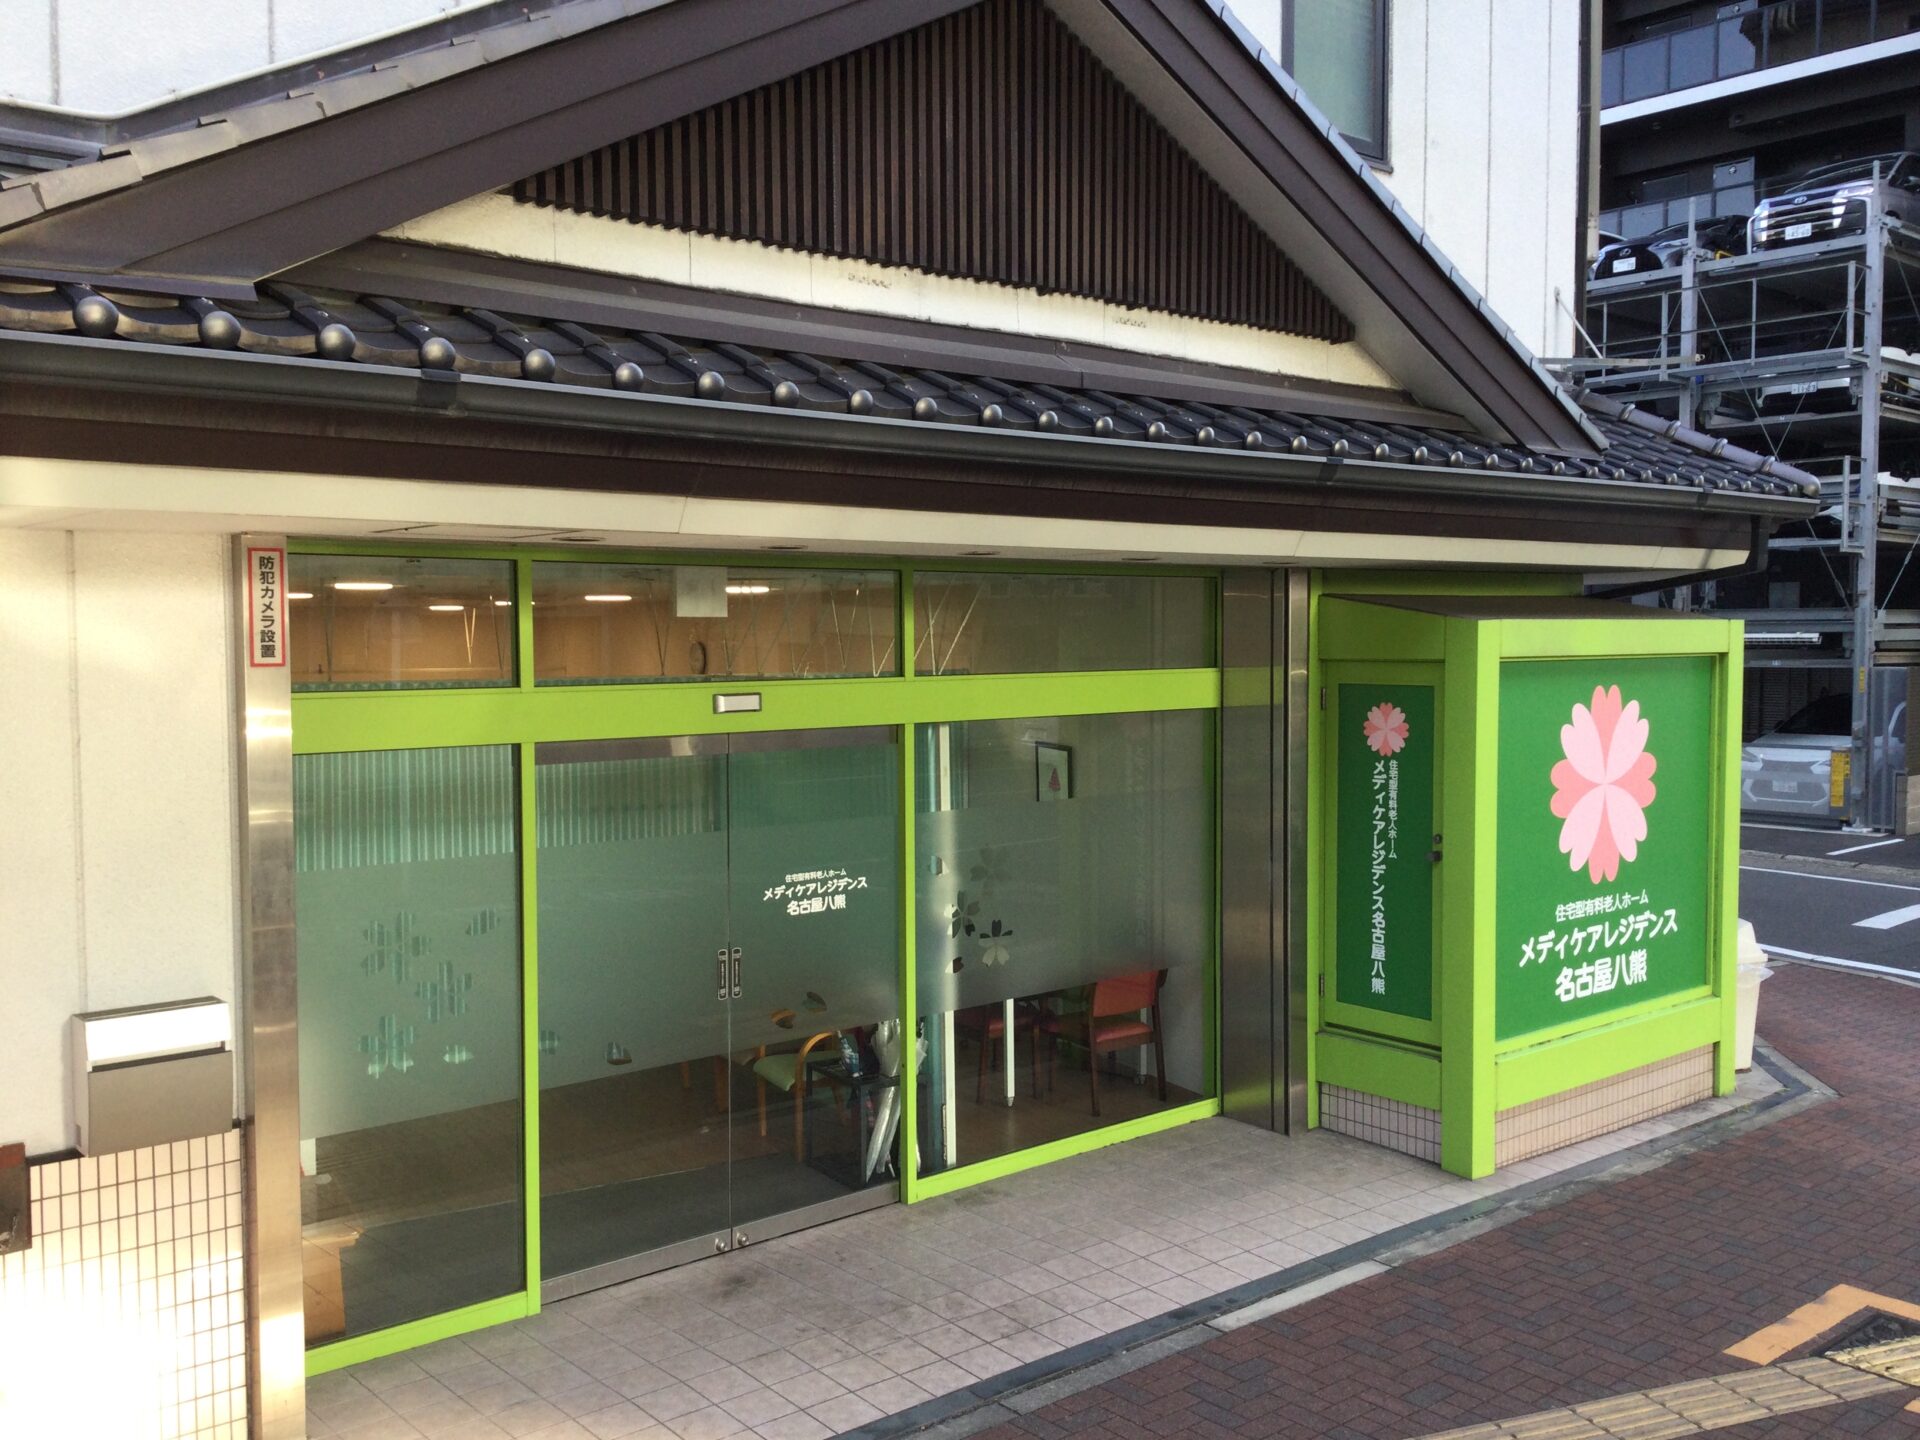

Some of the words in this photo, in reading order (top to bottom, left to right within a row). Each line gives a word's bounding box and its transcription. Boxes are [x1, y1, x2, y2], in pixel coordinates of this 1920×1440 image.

[259, 556, 276, 658] 防犯カメラ設置
[1388, 759, 1399, 859] 住宅型有料老人ホーム
[763, 877, 868, 901] メディケアレジデンス
[785, 868, 847, 883] 住宅型有料老人ホーム
[1371, 760, 1387, 995] メディケアレジデンス名古屋八熊
[786, 894, 847, 916] 名古屋八熊
[1555, 889, 1649, 922] 住宅型有料老人ホーム
[1519, 908, 1678, 968] メディケアレジデンス
[1555, 949, 1648, 1002] 名古屋八熊
